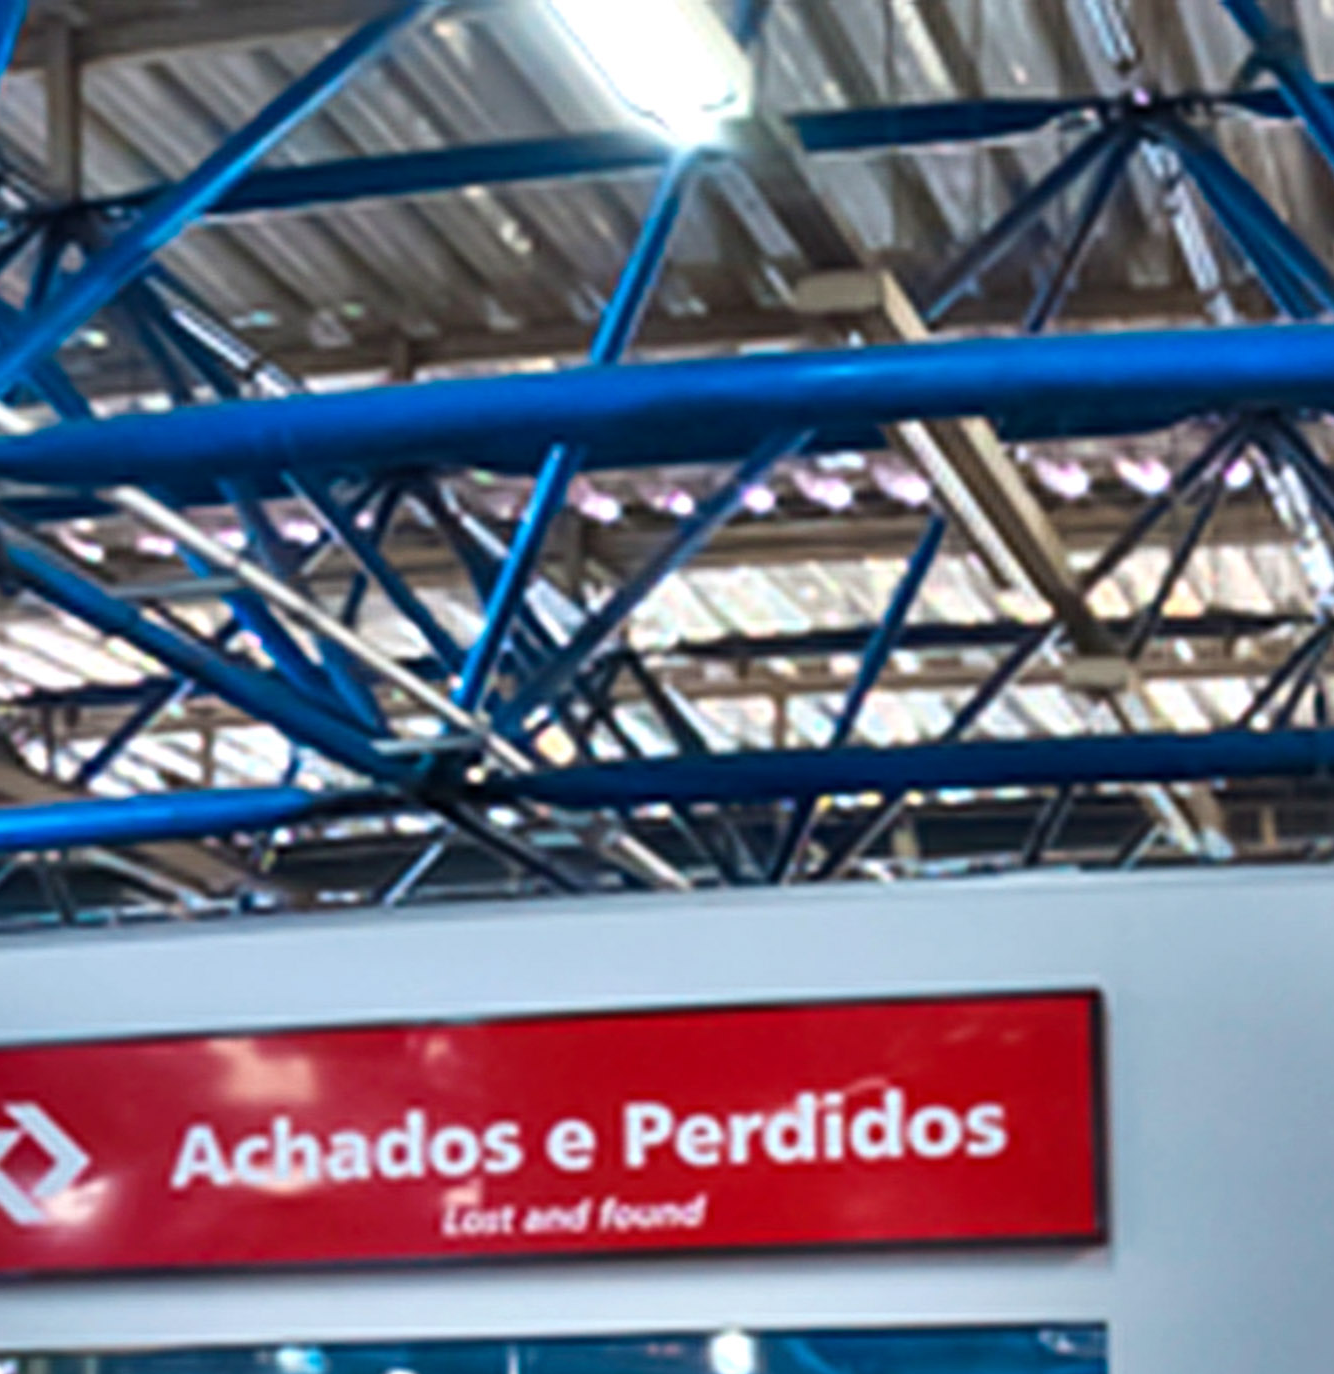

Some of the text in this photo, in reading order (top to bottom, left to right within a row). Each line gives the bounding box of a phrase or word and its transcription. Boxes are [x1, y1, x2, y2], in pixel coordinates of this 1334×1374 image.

[171, 1087, 1007, 1188] Achados e Perdidos
[441, 1195, 707, 1236] Lost and found
